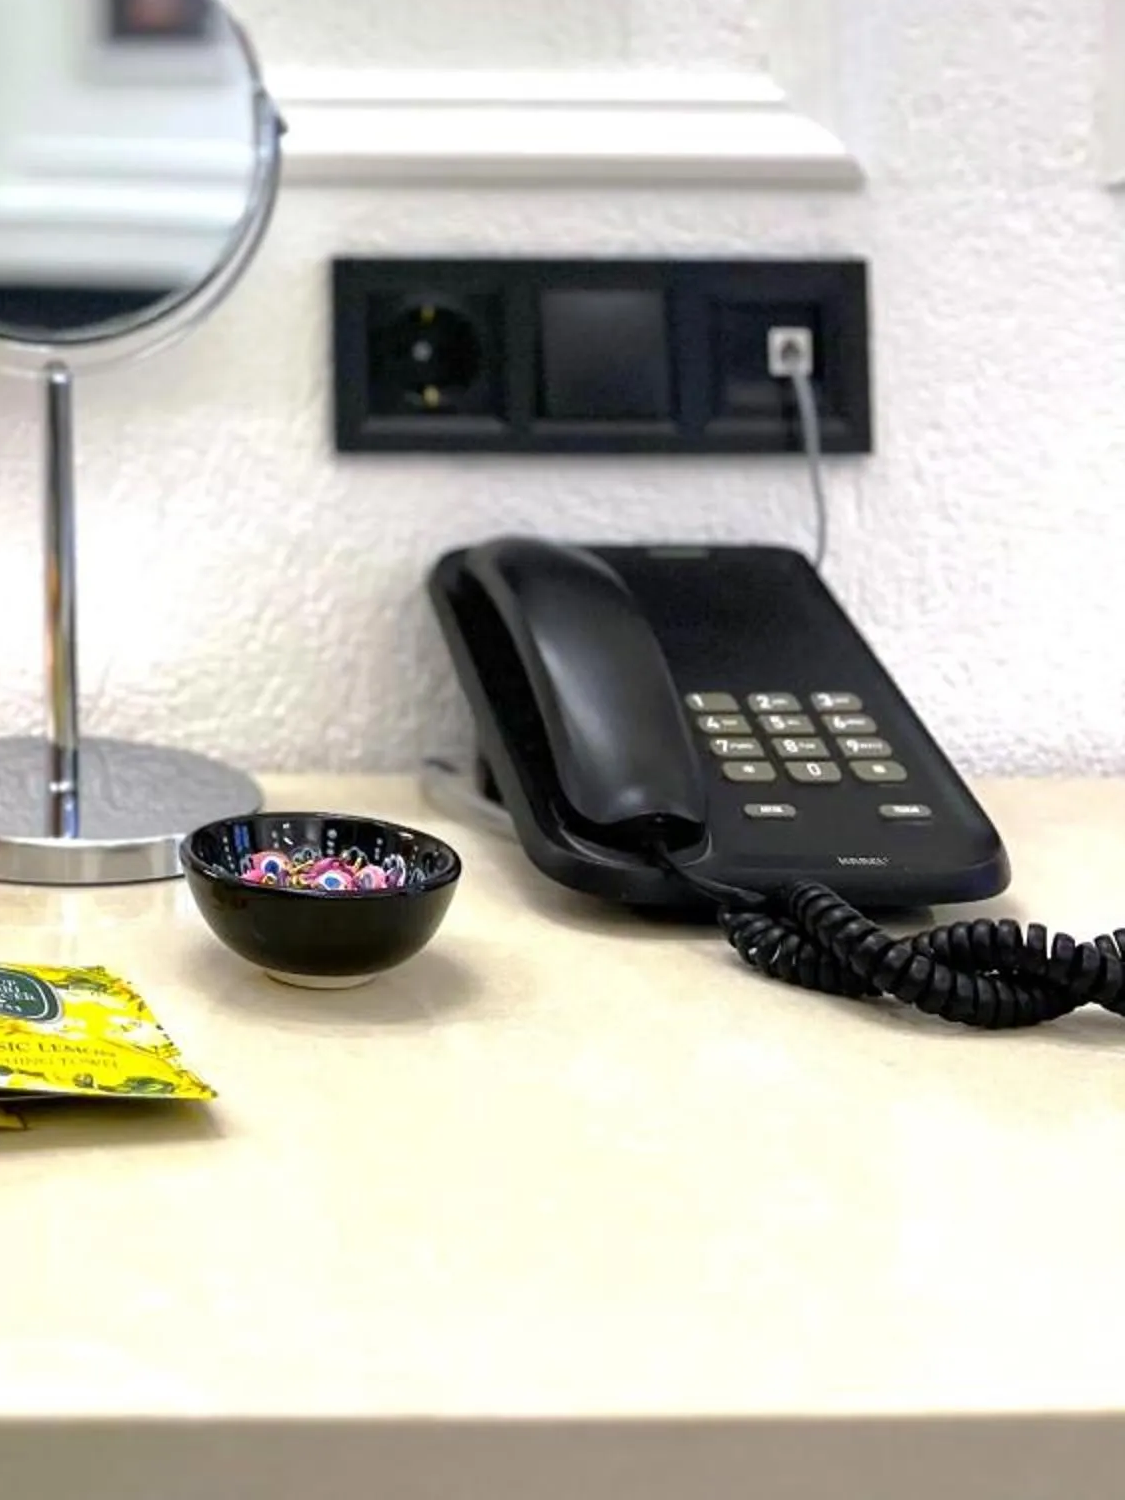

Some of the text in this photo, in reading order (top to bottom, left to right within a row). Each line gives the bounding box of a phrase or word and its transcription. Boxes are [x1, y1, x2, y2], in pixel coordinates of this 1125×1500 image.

[692, 694, 704, 707] 1
[756, 695, 771, 709] 2
[817, 694, 833, 707] 3
[706, 716, 720, 729] 4
[770, 716, 786, 729] 5
[833, 716, 846, 729] 6
[715, 739, 728, 752] 7
[783, 739, 798, 752] 8
[846, 739, 859, 752] 9
[806, 763, 822, 776] 0
[38, 1042, 116, 1057] LEMON
